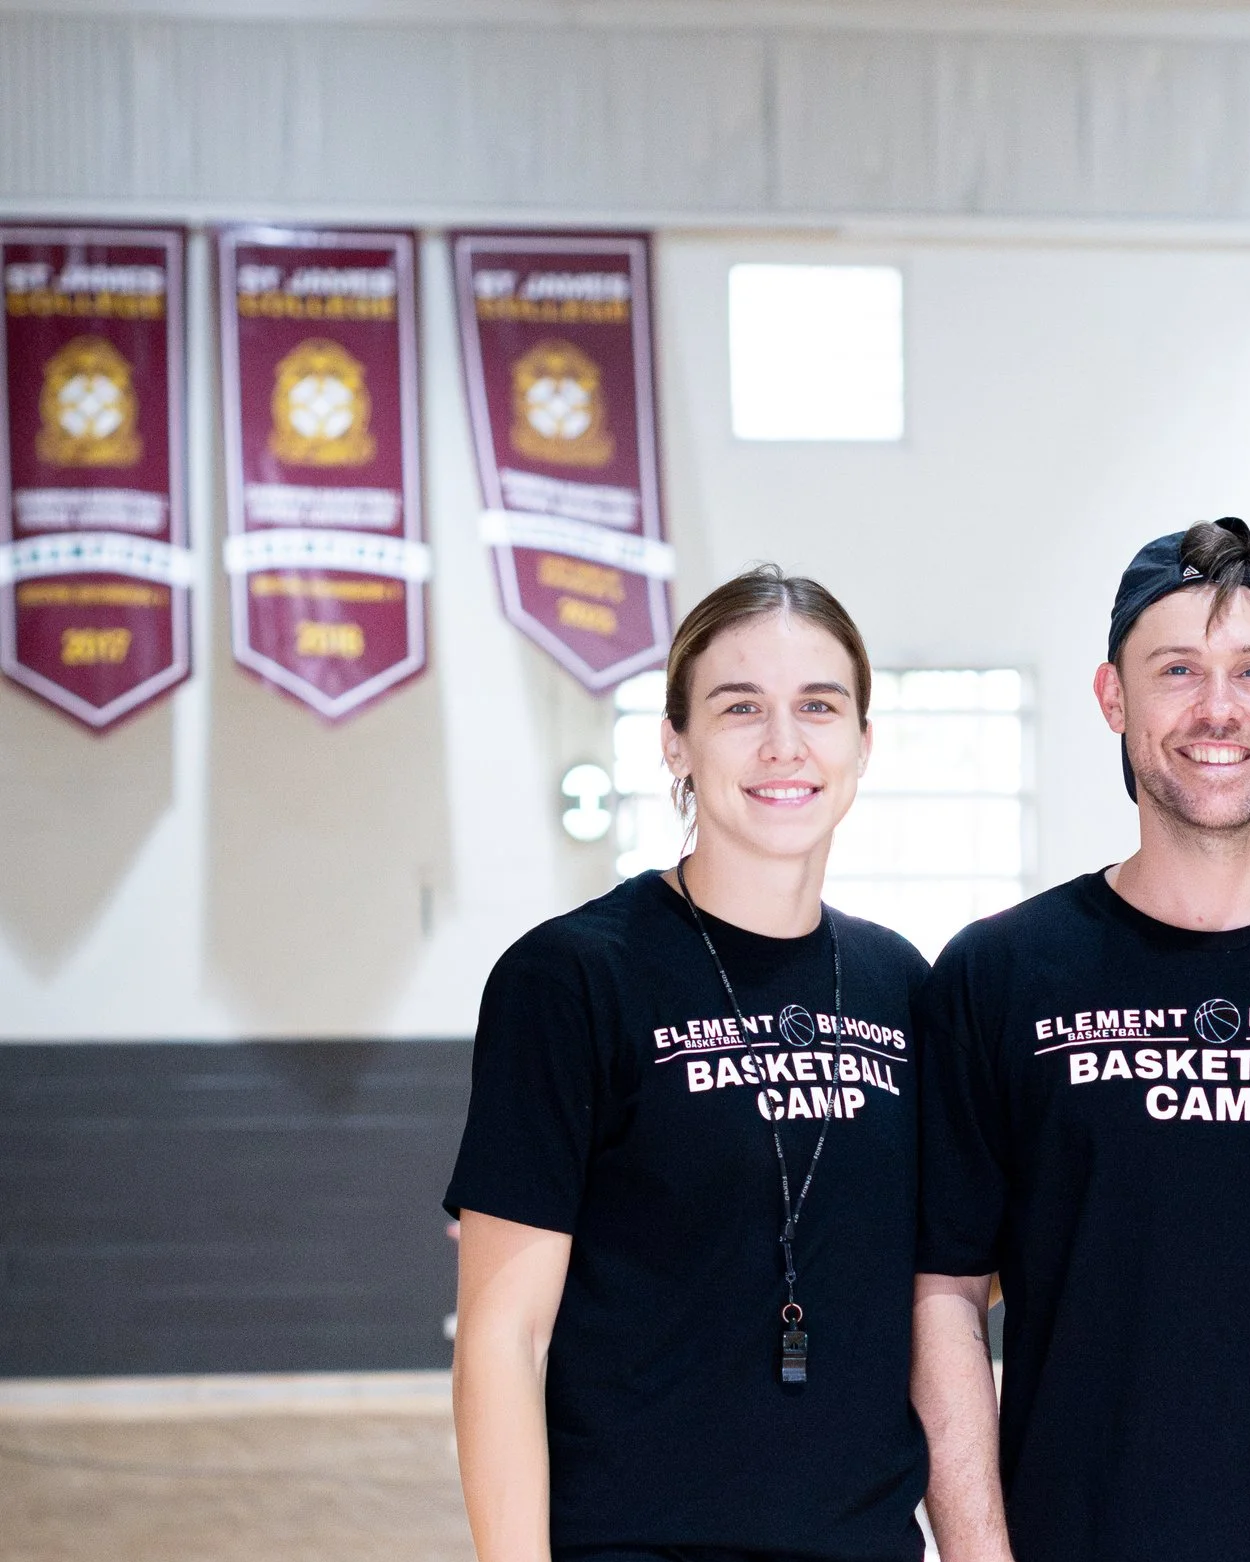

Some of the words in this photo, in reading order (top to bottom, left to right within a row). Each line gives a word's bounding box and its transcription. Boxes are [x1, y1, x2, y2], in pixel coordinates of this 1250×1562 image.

[654, 1015, 774, 1049] ELEMENT
[816, 1013, 906, 1049] BEHOOPS
[1035, 1008, 1188, 1041] ELEMENT
[1067, 1028, 1152, 1041] BASKETBALL
[687, 1051, 900, 1096] BASKETBALL
[757, 1086, 866, 1121] CAMP
